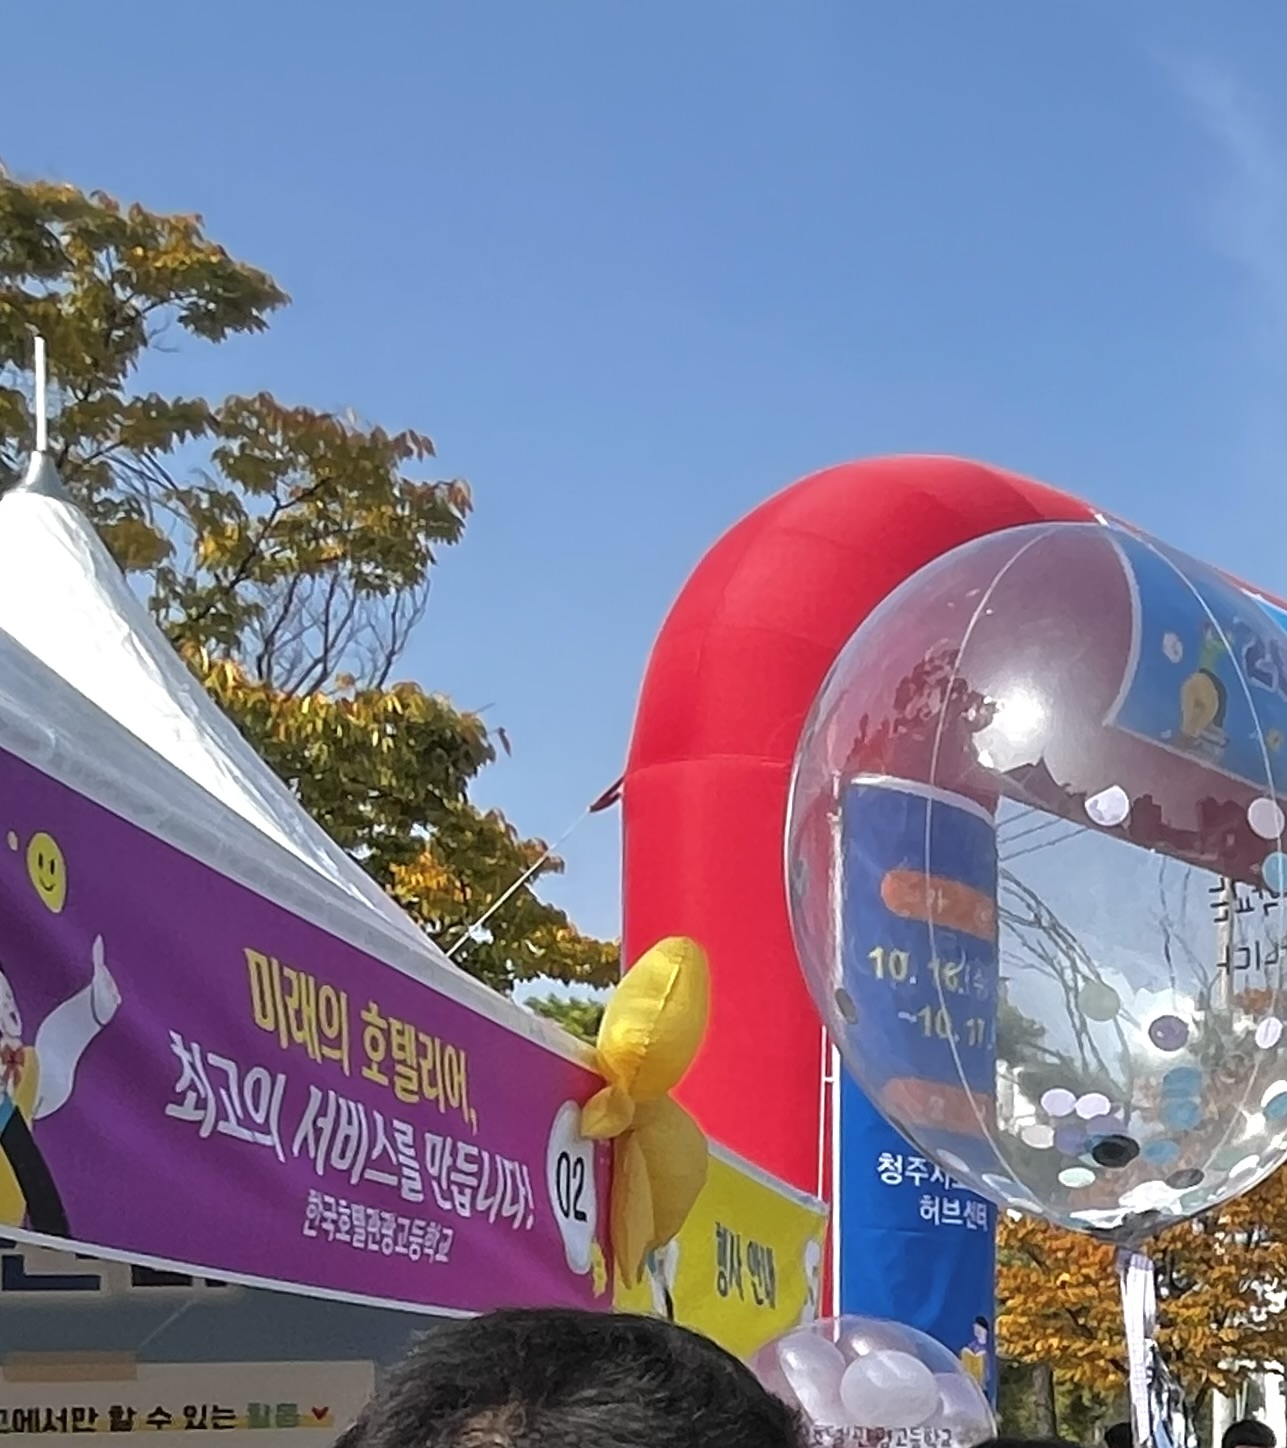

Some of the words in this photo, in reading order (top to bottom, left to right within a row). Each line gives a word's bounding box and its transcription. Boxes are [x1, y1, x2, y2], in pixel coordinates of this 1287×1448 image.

[244, 949, 350, 1077] 미래의
[360, 1000, 478, 1136] 호텔리어,
[165, 1030, 287, 1163] 최고의
[291, 1085, 424, 1203] 서비스를
[424, 1132, 535, 1231] 만듭니다!
[555, 1151, 589, 1224] 02
[920, 1194, 988, 1232] 허브센터
[302, 1190, 455, 1263] 한국호텔관광고등학교
[715, 1221, 744, 1301] 행사
[108, 1405, 137, 1432] 할
[146, 1406, 173, 1431] 수
[183, 1404, 236, 1430] 있는
